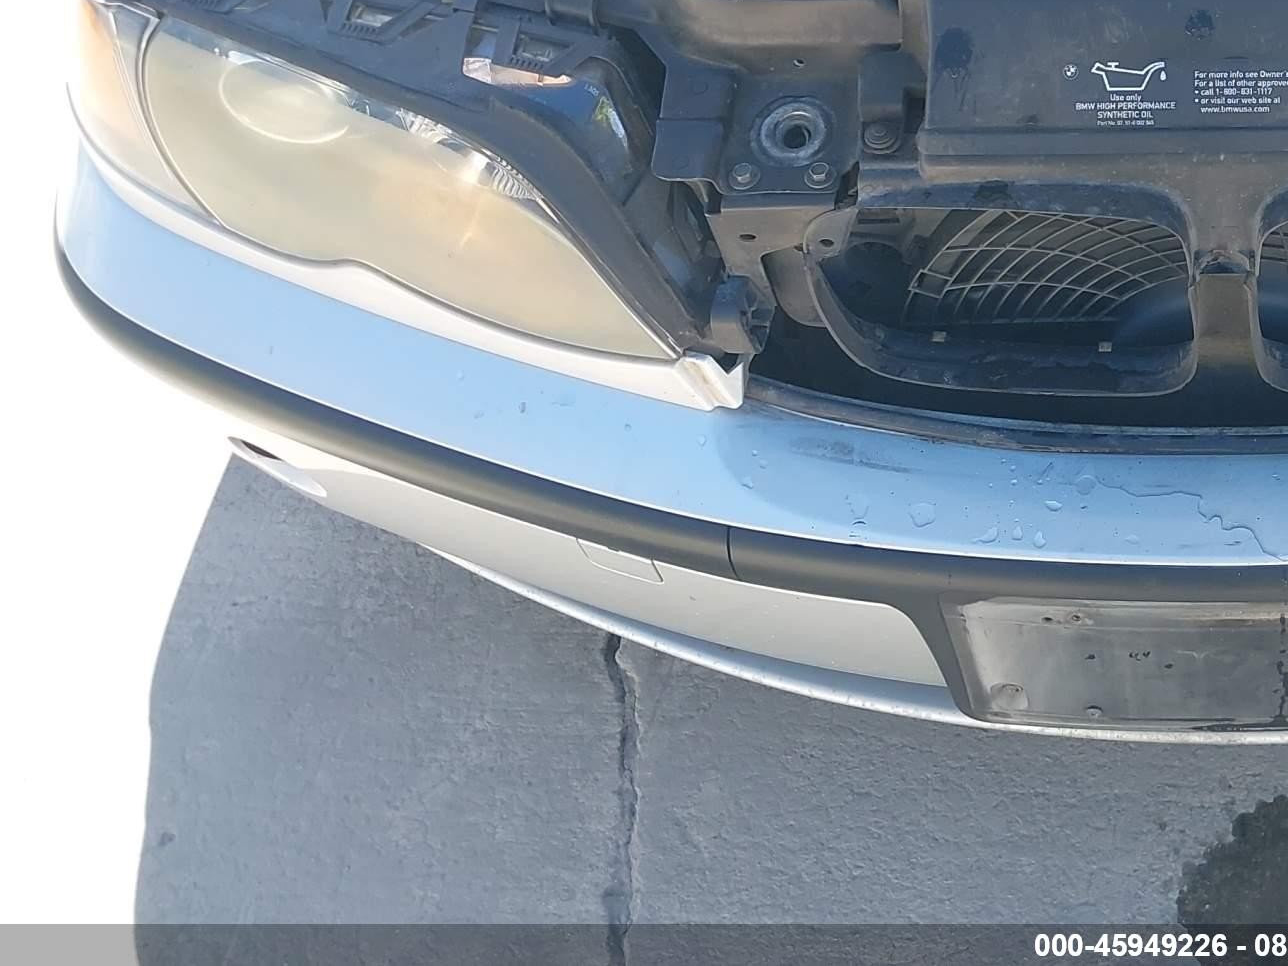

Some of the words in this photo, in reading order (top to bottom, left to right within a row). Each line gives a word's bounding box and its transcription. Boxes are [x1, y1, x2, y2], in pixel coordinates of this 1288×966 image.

[1195, 79, 1207, 87] For
[1215, 79, 1227, 87] list
[1227, 79, 1235, 87] of
[1236, 79, 1256, 87] other
[1200, 88, 1214, 96] call
[1125, 94, 1142, 102] only
[1075, 102, 1095, 110] BMW
[1096, 102, 1116, 110] HIGH
[1117, 101, 1176, 110] PERFORMANCE
[1200, 105, 1270, 114] www.bmwusa.com
[1097, 110, 1140, 119] SYNTHETIC
[1140, 110, 1154, 119] OIL
